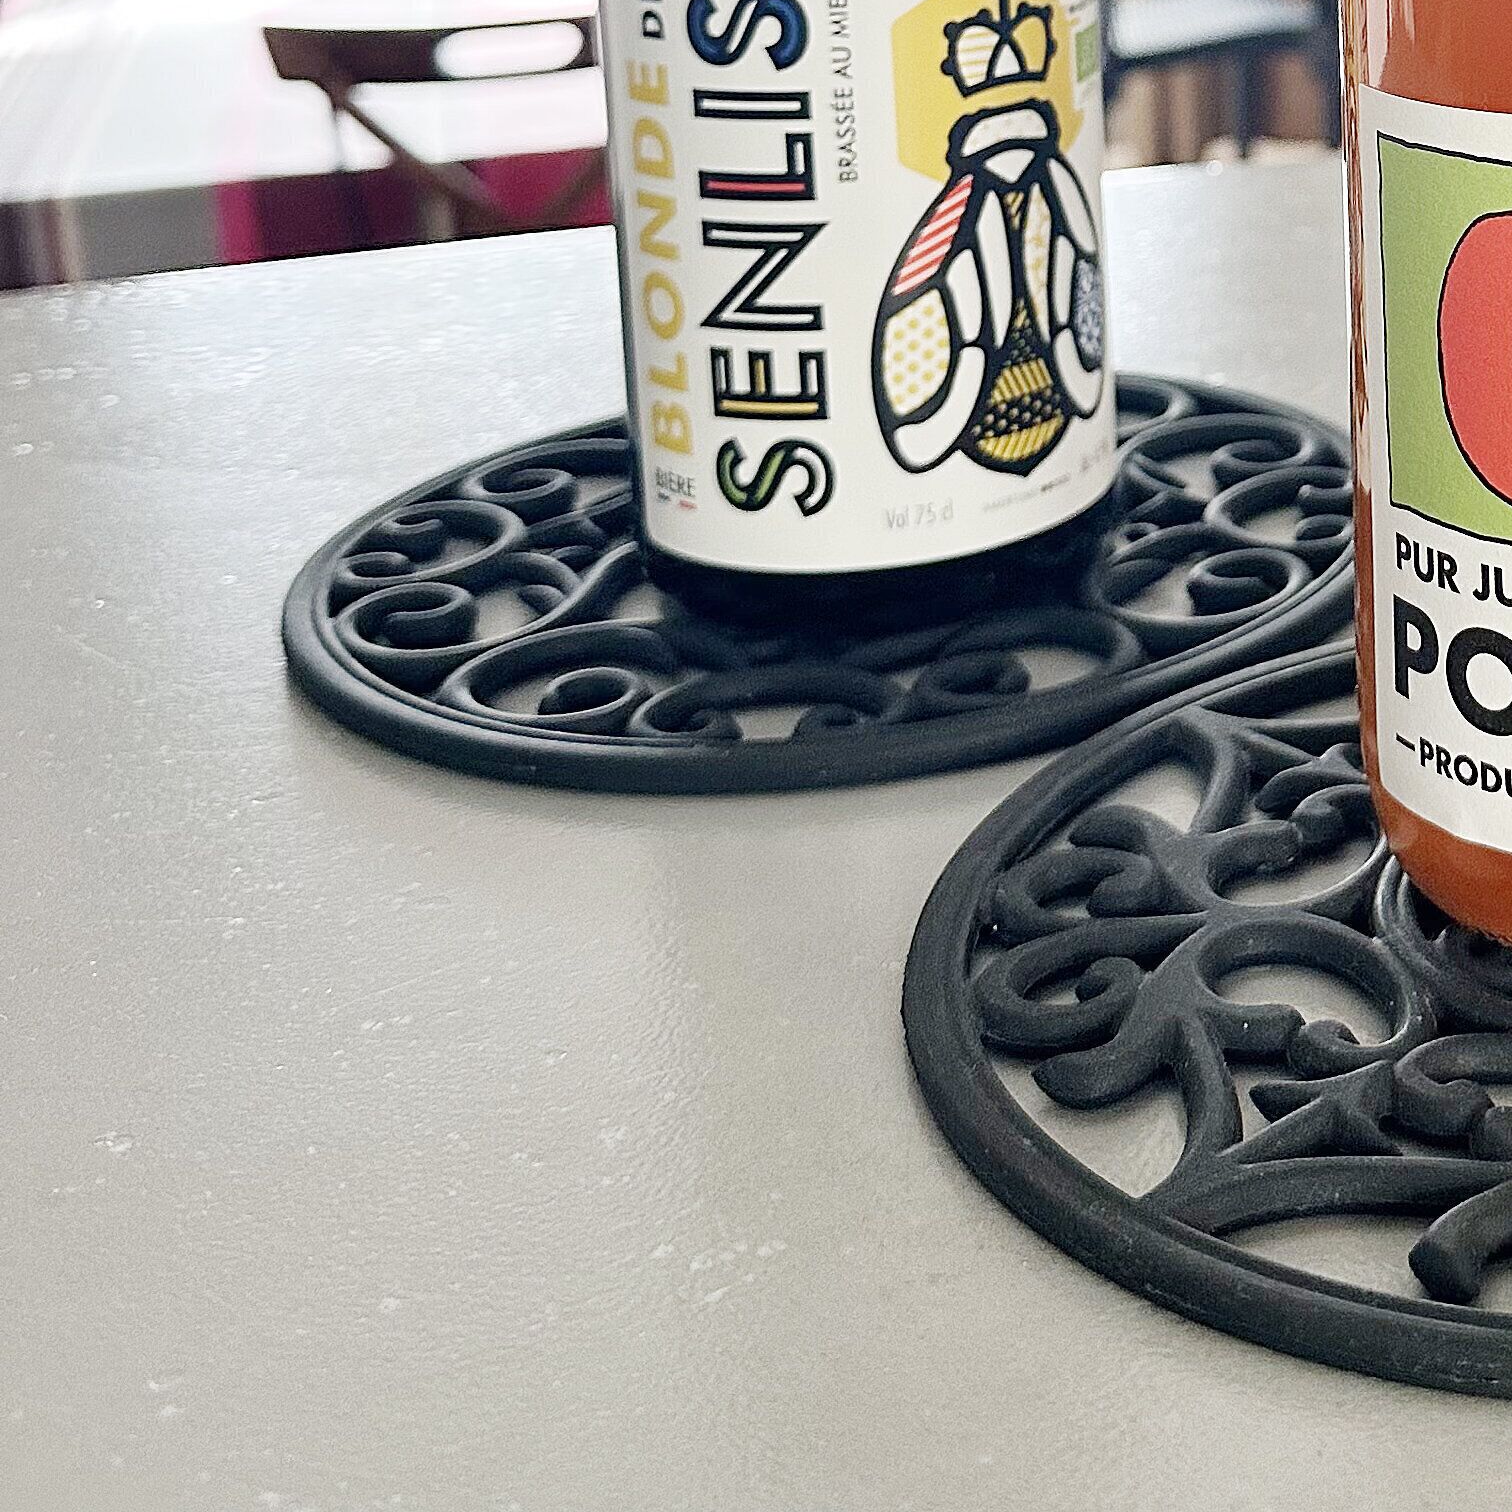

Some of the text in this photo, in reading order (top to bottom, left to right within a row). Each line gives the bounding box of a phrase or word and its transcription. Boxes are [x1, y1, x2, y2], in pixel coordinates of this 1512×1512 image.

[832, 45, 852, 79] AU
[831, 87, 858, 183] BRASSÉE
[626, 58, 694, 455] BLONDE
[1396, 531, 1459, 595] PUR
